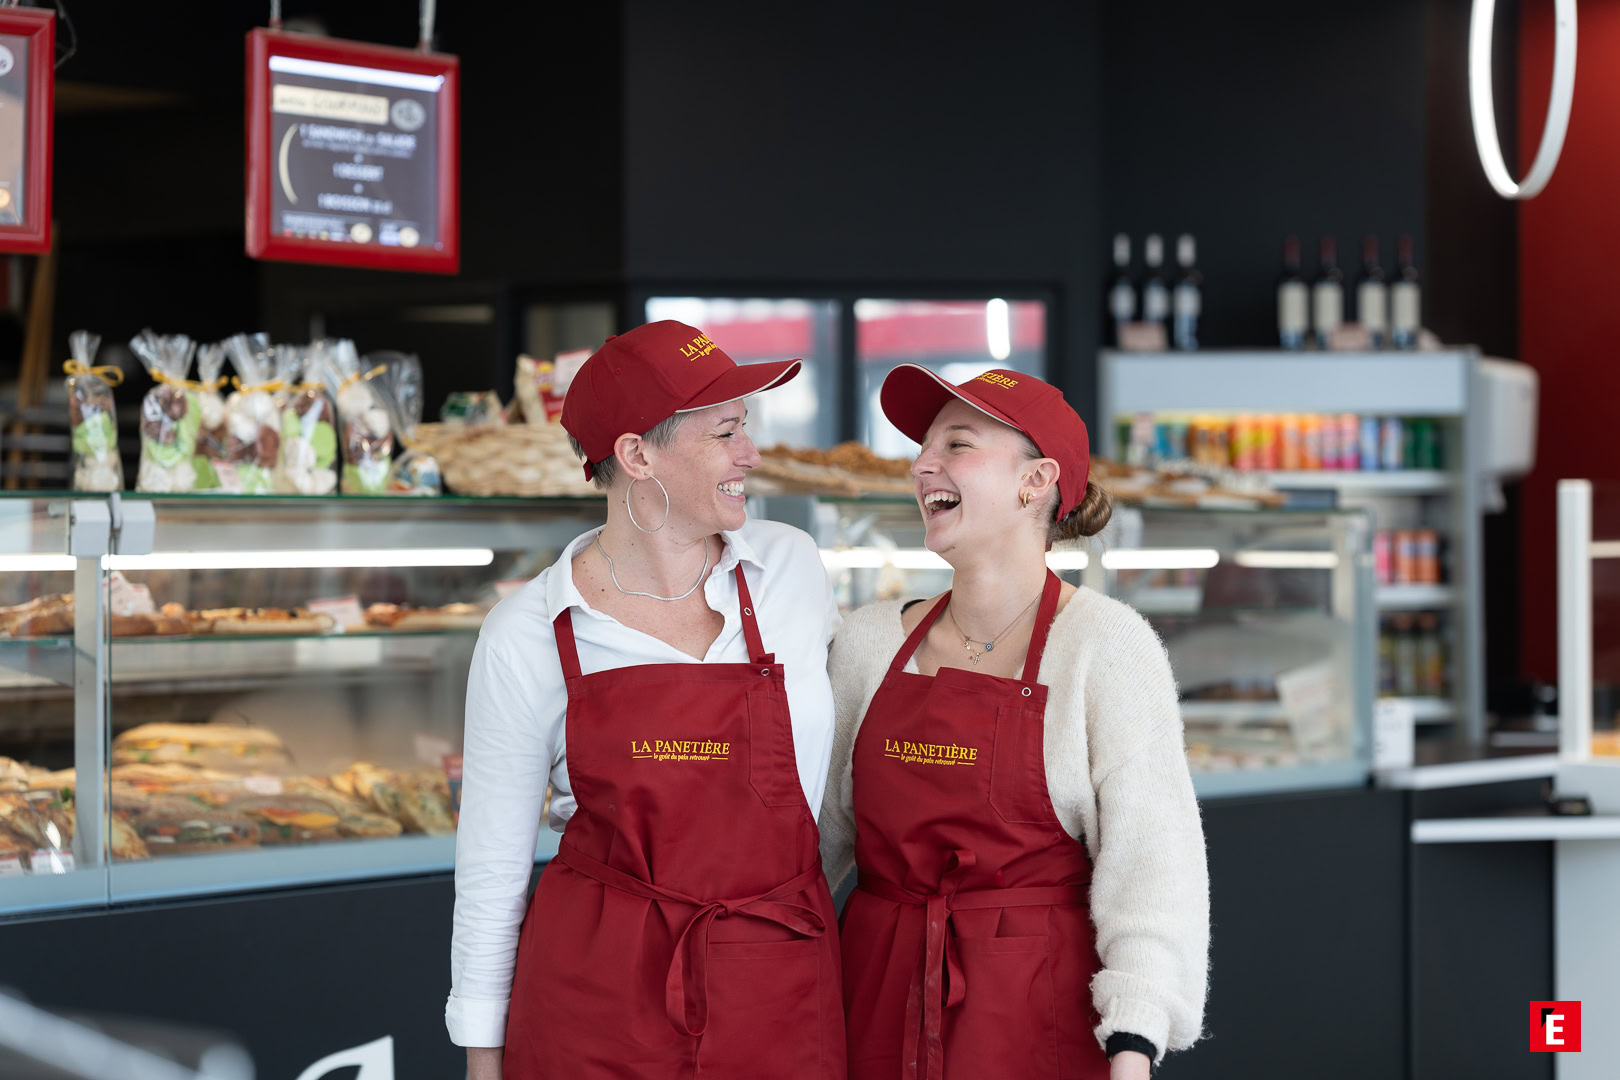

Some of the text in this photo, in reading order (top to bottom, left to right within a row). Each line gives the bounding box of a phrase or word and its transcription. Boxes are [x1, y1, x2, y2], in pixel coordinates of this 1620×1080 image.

[679, 343, 699, 357] LA
[631, 739, 730, 755] LA PANETIÈRE
[885, 739, 978, 760] LA PANETIÈRE
